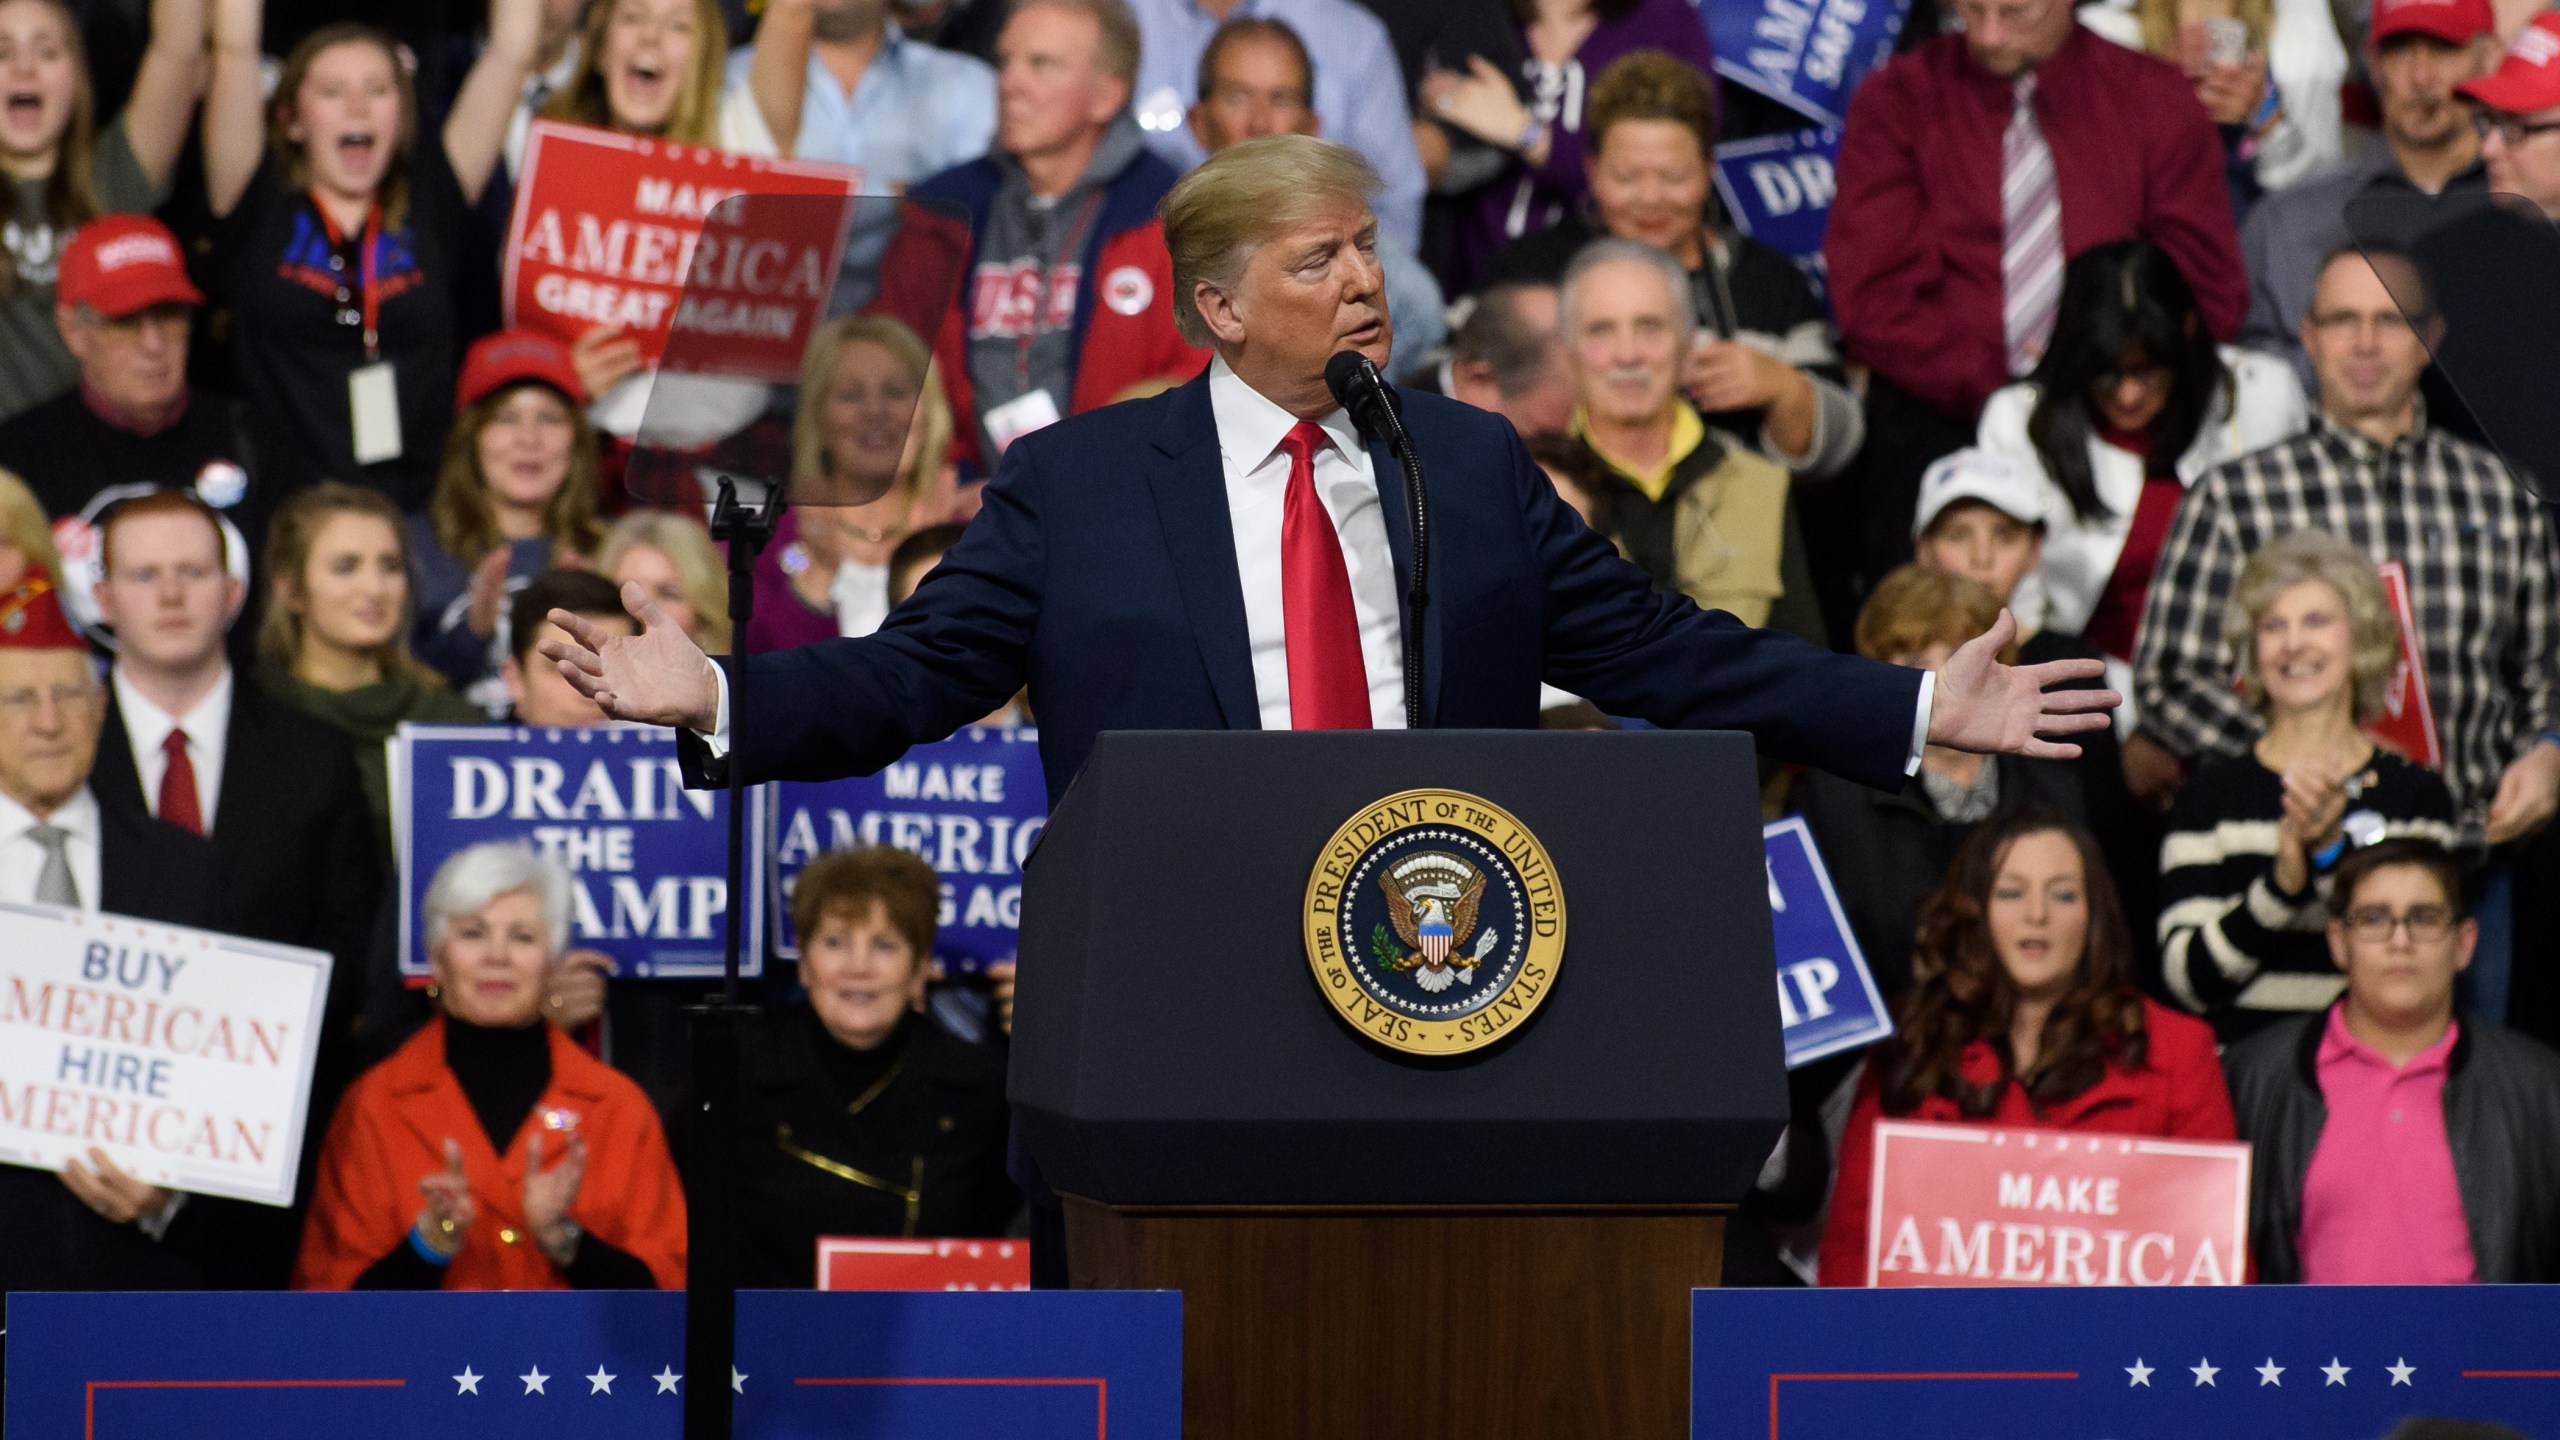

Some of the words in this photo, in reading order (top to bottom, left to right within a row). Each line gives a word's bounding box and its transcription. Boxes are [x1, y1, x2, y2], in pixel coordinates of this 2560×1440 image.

[1748, 0, 1822, 95] AM
[635, 176, 748, 226] MAKE
[1749, 153, 1837, 217] DR
[521, 208, 825, 297] AMERICA
[534, 273, 673, 331] GREAT
[676, 296, 799, 342] AGAIN
[448, 756, 715, 821] DRAIN
[884, 762, 1005, 803] MAKE
[1436, 803, 1459, 818] OF
[533, 826, 634, 872] THE
[779, 807, 1048, 875] AMERIC
[1466, 808, 1497, 832] THE
[1313, 800, 1427, 916] PRESIDENT
[1504, 830, 1557, 937] UNITED
[81, 939, 186, 994] BUY
[1317, 927, 1336, 962] THE
[1328, 968, 1346, 989] OF
[1461, 963, 1546, 1041] STATES
[0, 974, 290, 1069] MERICAN
[1347, 987, 1412, 1041] SEAL
[58, 1043, 173, 1100] HIRE
[0, 1077, 273, 1166] MERICAN
[1998, 1170, 2119, 1216] MAKE
[1879, 1215, 2225, 1286] AMERICA
